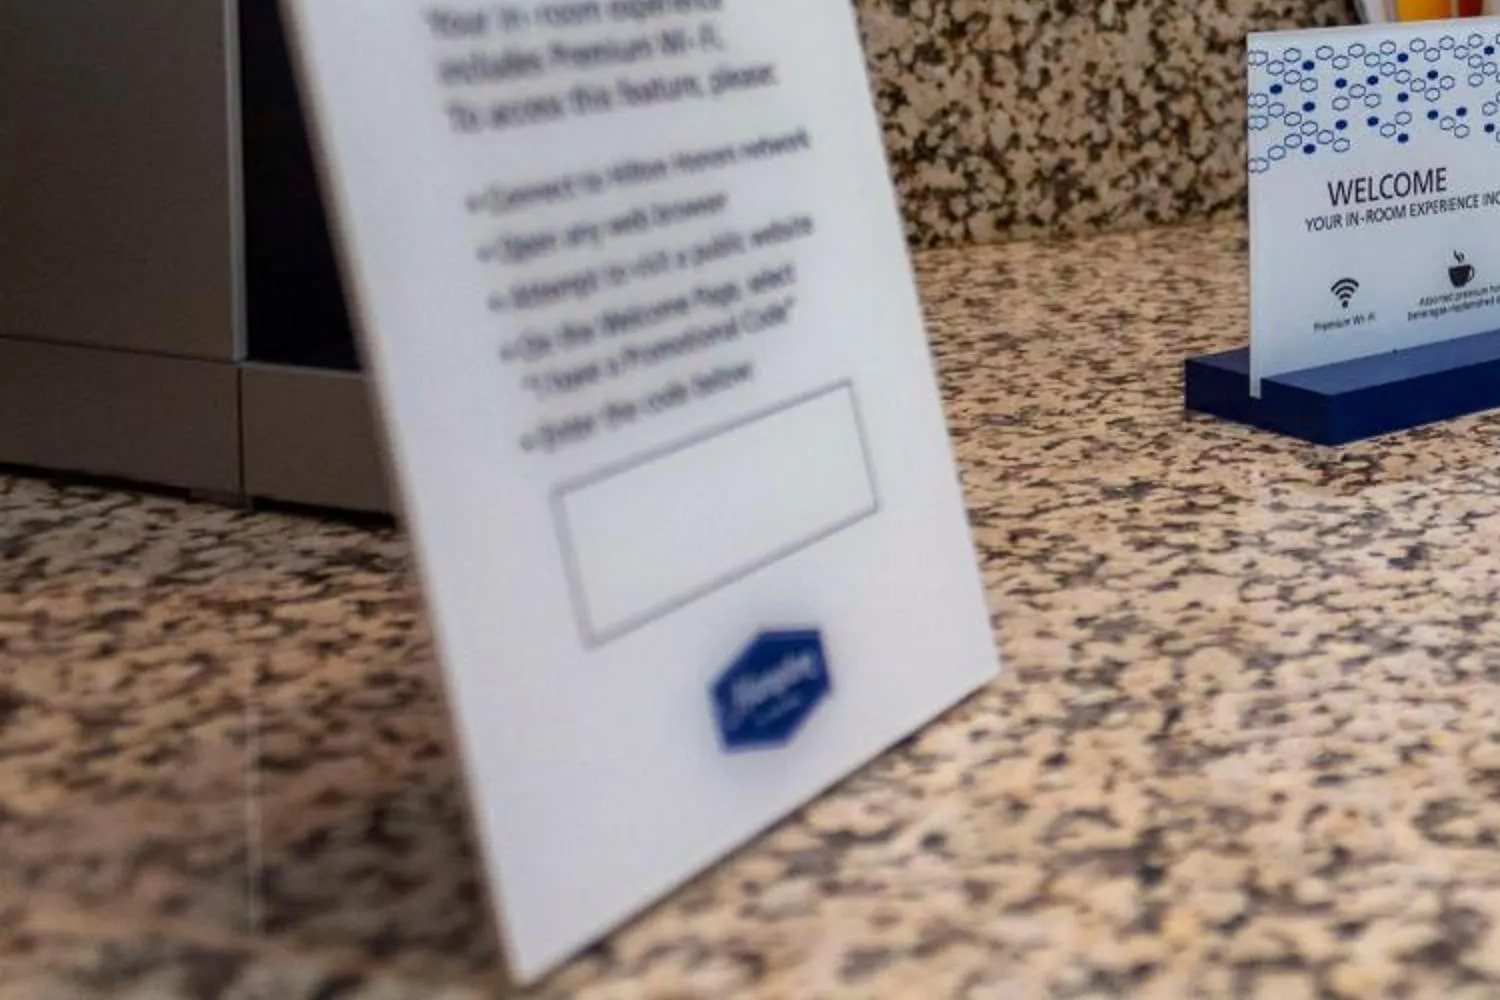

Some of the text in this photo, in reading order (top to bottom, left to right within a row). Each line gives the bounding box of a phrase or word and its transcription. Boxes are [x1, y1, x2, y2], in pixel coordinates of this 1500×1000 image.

[424, 6, 487, 36] Your
[549, 36, 653, 67] Premium
[446, 102, 482, 133] To
[490, 95, 564, 128] access
[570, 83, 611, 113] this
[1327, 167, 1447, 206] WELCOME
[607, 208, 650, 238] web
[1305, 214, 1342, 232] YOUR
[1345, 205, 1406, 226] IN-ROOM
[1409, 194, 1479, 218] EXPERIENCE
